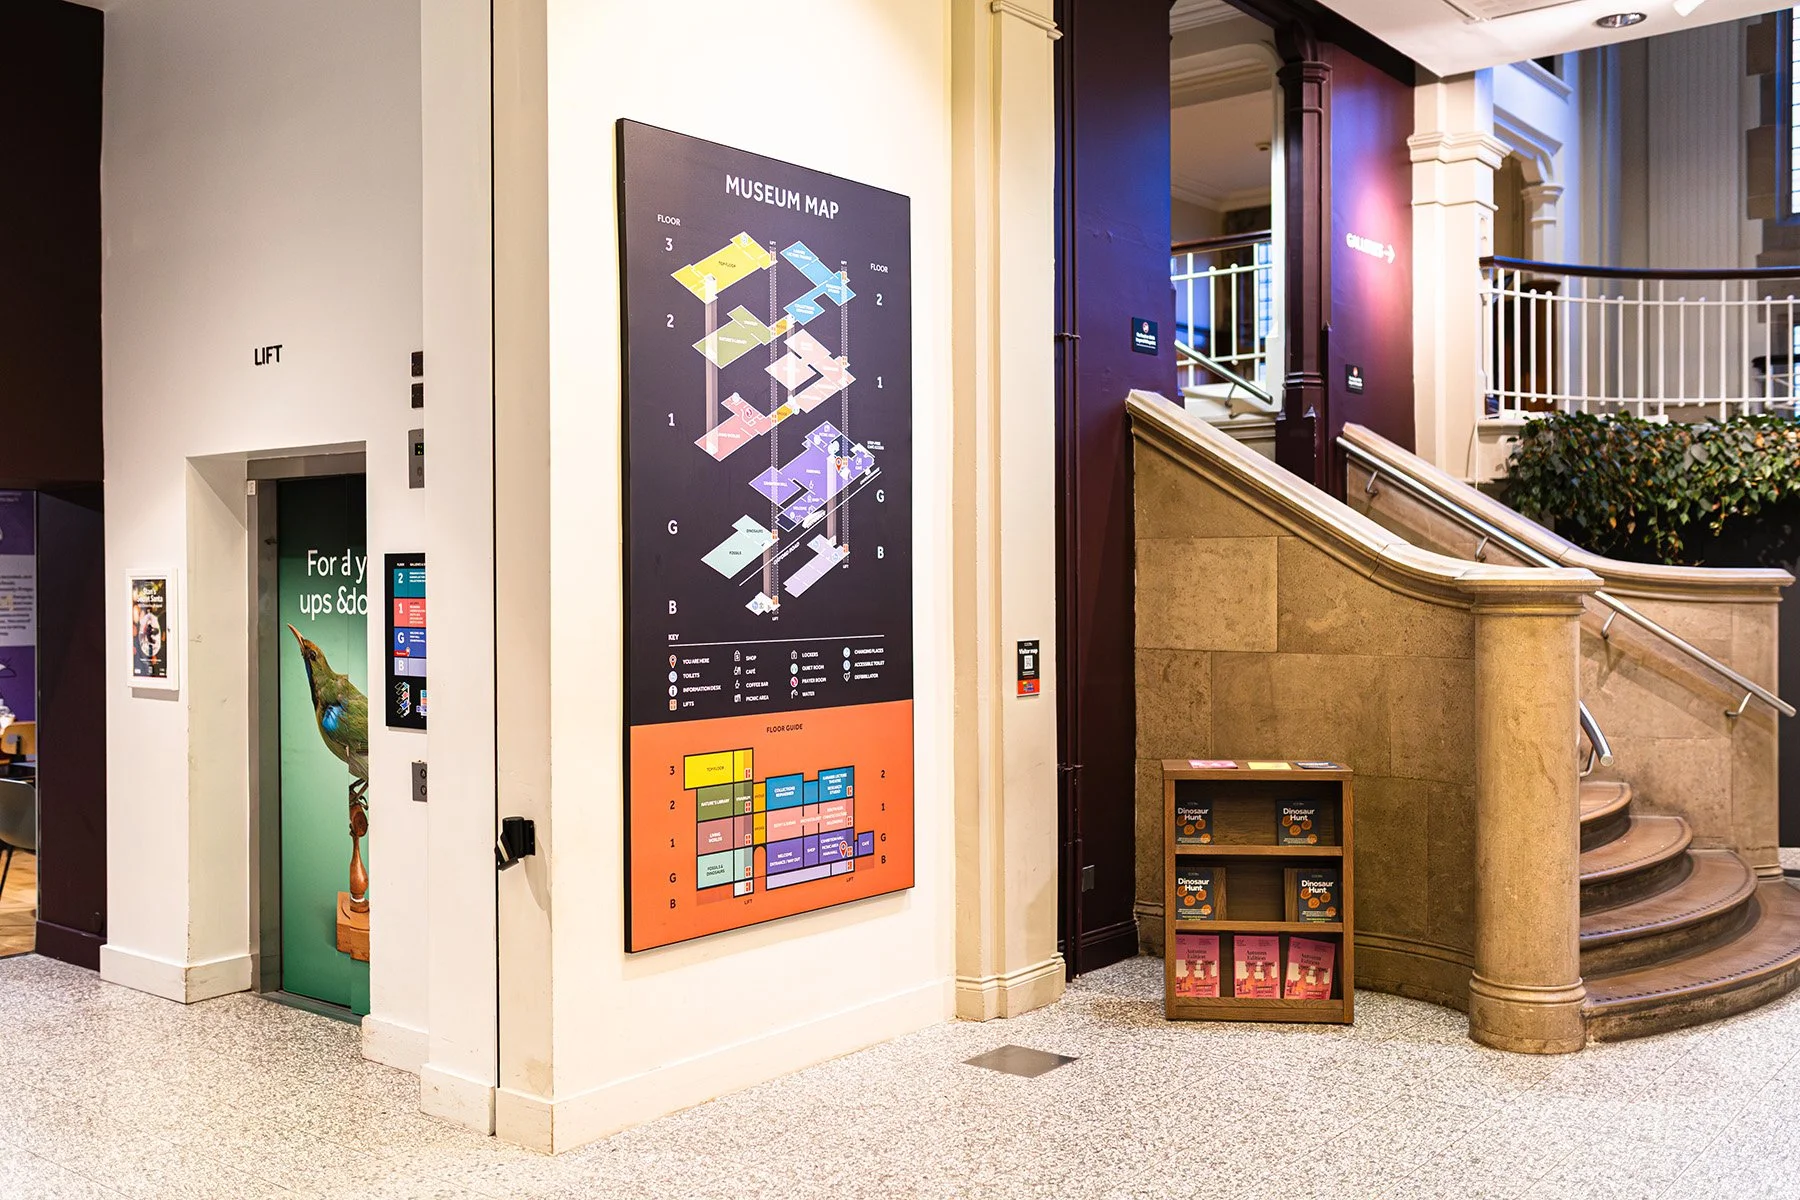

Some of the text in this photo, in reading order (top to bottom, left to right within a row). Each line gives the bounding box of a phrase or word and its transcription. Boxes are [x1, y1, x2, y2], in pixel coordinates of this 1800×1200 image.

[726, 174, 839, 219] MUSEUM MAP
[657, 213, 681, 226] FLOOR
[665, 237, 673, 252] 3
[870, 263, 889, 273] FLOOR
[876, 293, 883, 306] 2
[666, 313, 674, 328] 2
[254, 344, 283, 366] LIFT
[877, 376, 883, 389] 1
[668, 413, 675, 426] 1
[876, 489, 885, 503] G
[667, 520, 678, 534] G
[877, 546, 885, 559] B
[307, 549, 338, 577] For
[398, 572, 404, 584] 2
[300, 593, 333, 621] ups
[398, 602, 403, 614] 1
[668, 600, 677, 614] B
[398, 632, 405, 644] G
[398, 660, 405, 671] B
[786, 723, 803, 731] GUIDE
[670, 766, 675, 776] 3
[881, 770, 886, 778] 2
[670, 800, 675, 810] 2
[881, 803, 885, 811] 1
[1177, 807, 1209, 815] Dinosaur
[1283, 807, 1315, 815] Dinosaur
[670, 838, 675, 848] 1
[880, 833, 886, 842] G
[880, 855, 887, 864] B
[669, 873, 677, 883] G
[1177, 877, 1210, 885] Dinosaur
[1301, 879, 1334, 887] Dinosaur
[670, 899, 677, 909] B
